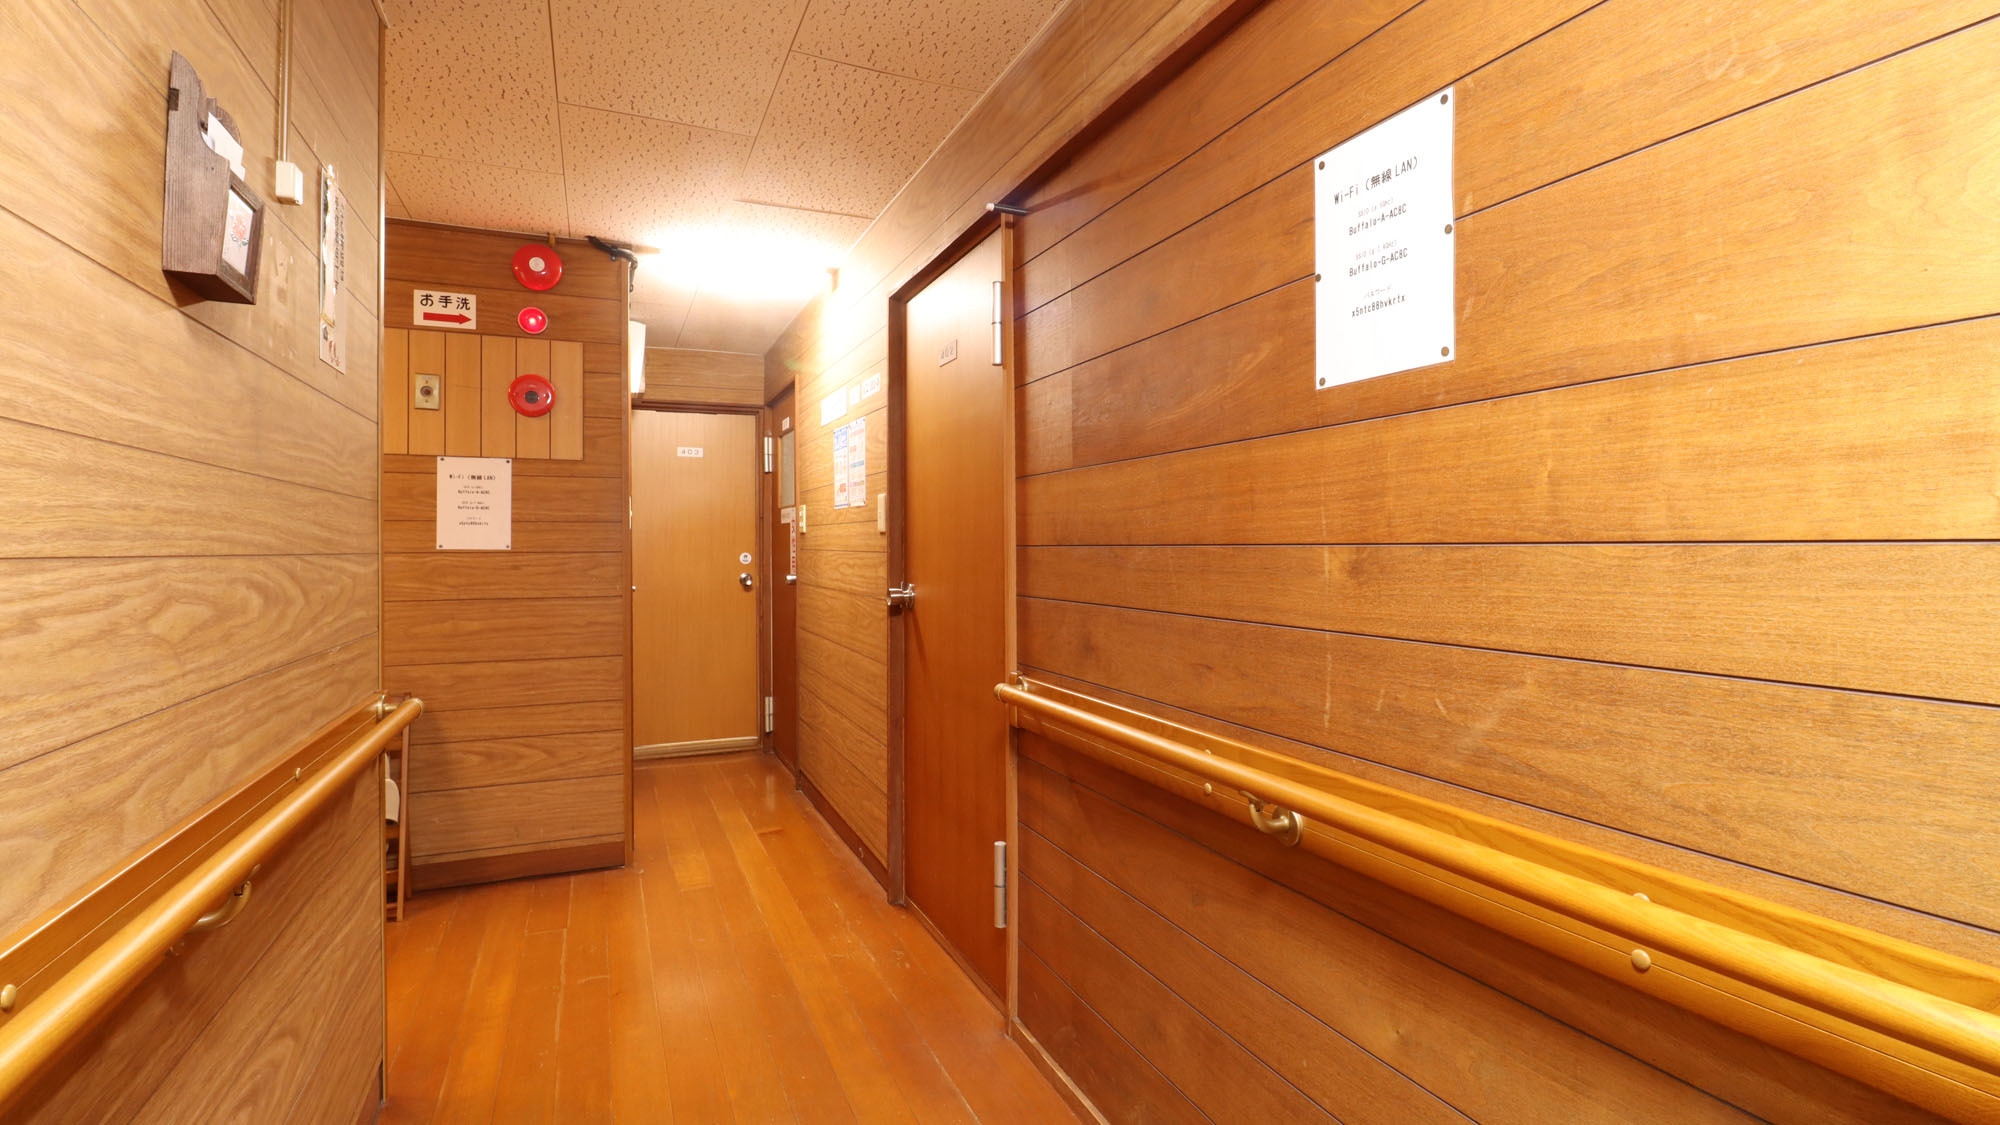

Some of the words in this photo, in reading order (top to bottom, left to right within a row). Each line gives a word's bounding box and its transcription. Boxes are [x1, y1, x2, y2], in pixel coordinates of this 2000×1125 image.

[1333, 184, 1359, 205] Wi-Fi
[420, 293, 471, 310] お手洗
